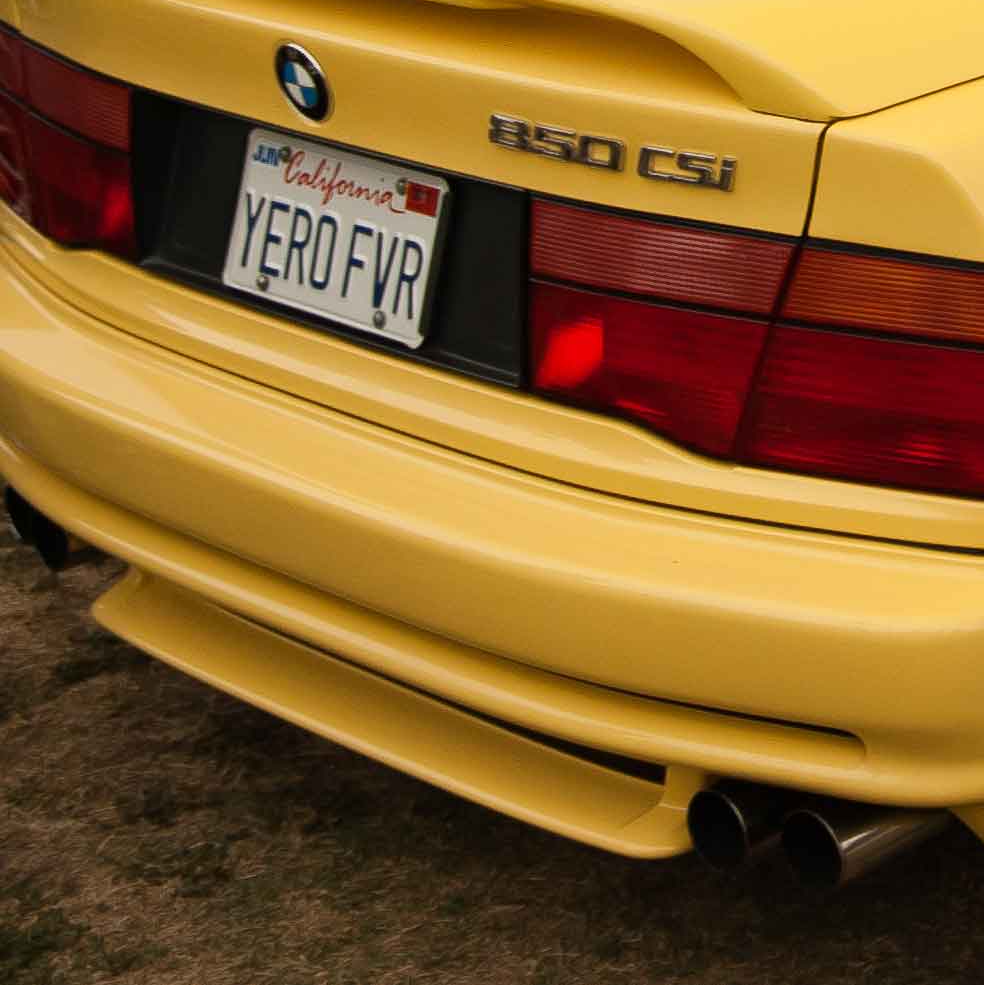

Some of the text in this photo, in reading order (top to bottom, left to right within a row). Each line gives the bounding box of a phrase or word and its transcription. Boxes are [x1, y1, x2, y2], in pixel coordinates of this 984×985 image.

[283, 151, 406, 214] California
[488, 112, 738, 193] 850 CSi
[240, 192, 424, 320] YERO FVR
